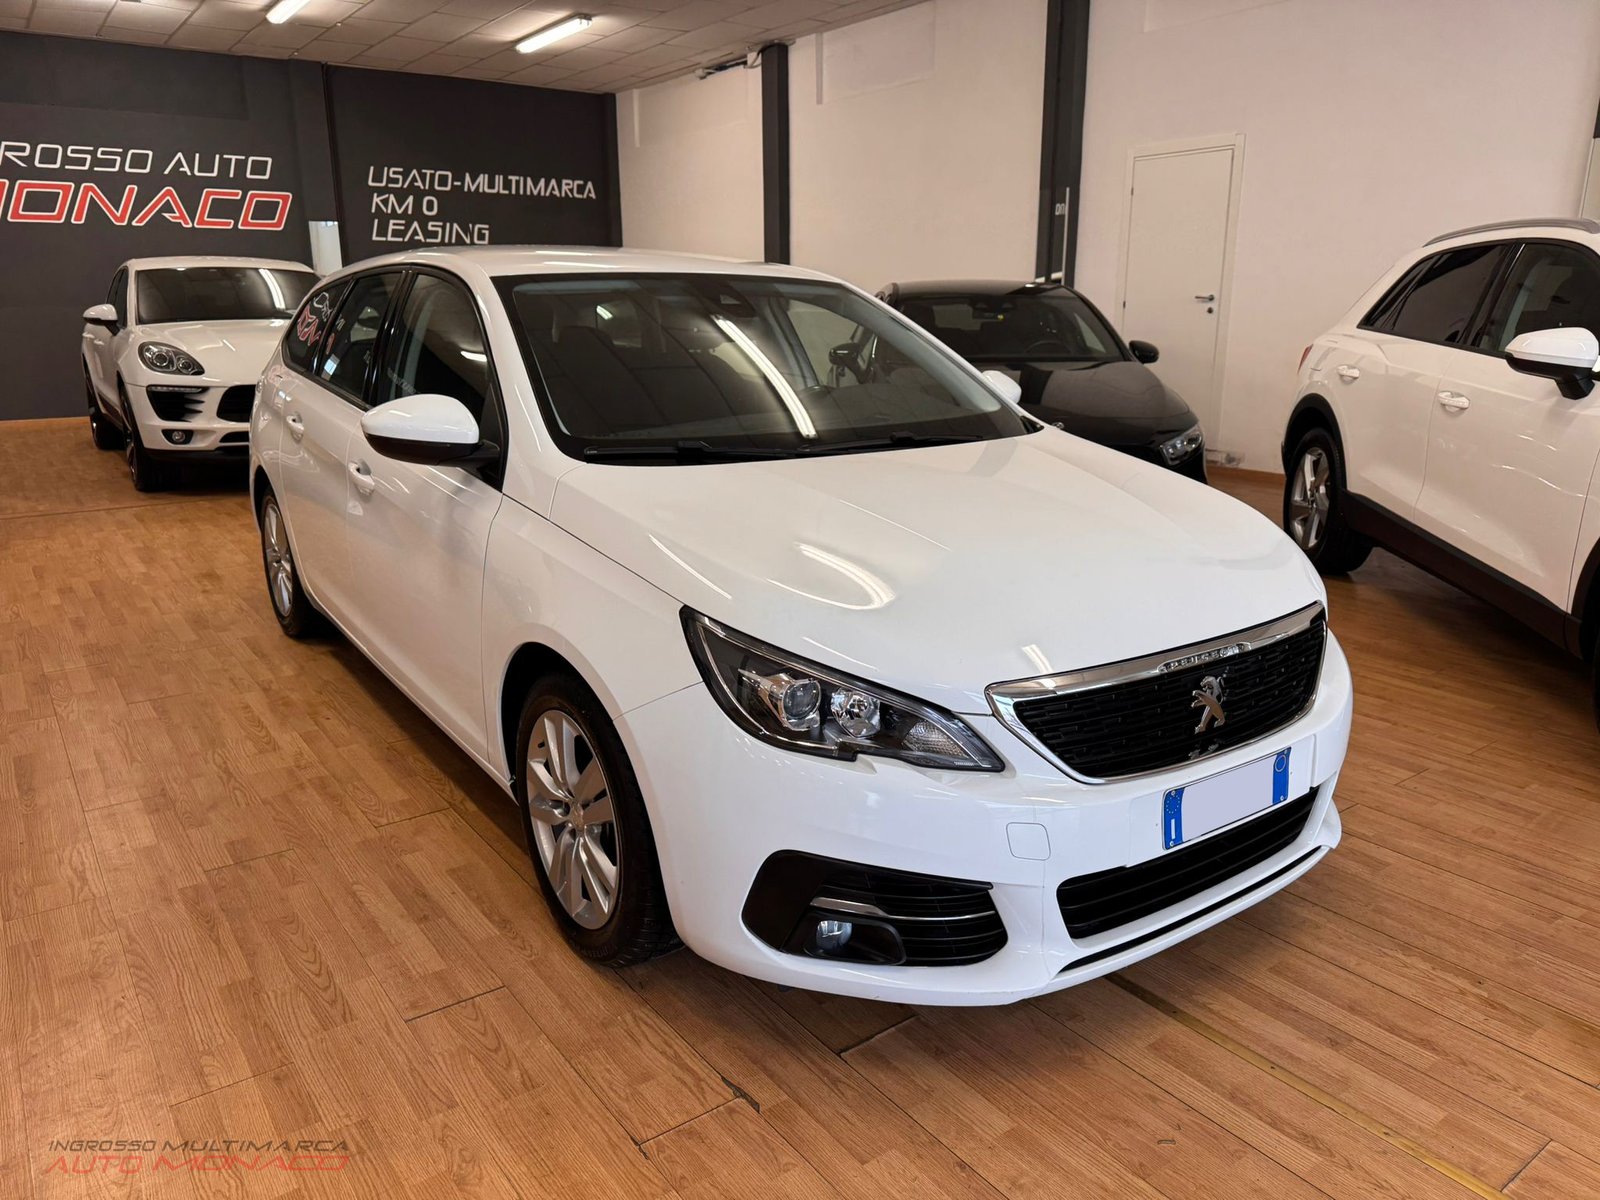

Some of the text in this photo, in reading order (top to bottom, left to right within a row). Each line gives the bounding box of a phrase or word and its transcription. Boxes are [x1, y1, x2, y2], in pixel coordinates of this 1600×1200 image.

[0, 141, 272, 180] ROSSO AUTO
[367, 165, 596, 200] USATO-MULTIMARCA
[371, 193, 413, 215] KM
[371, 218, 489, 245] LEASING
